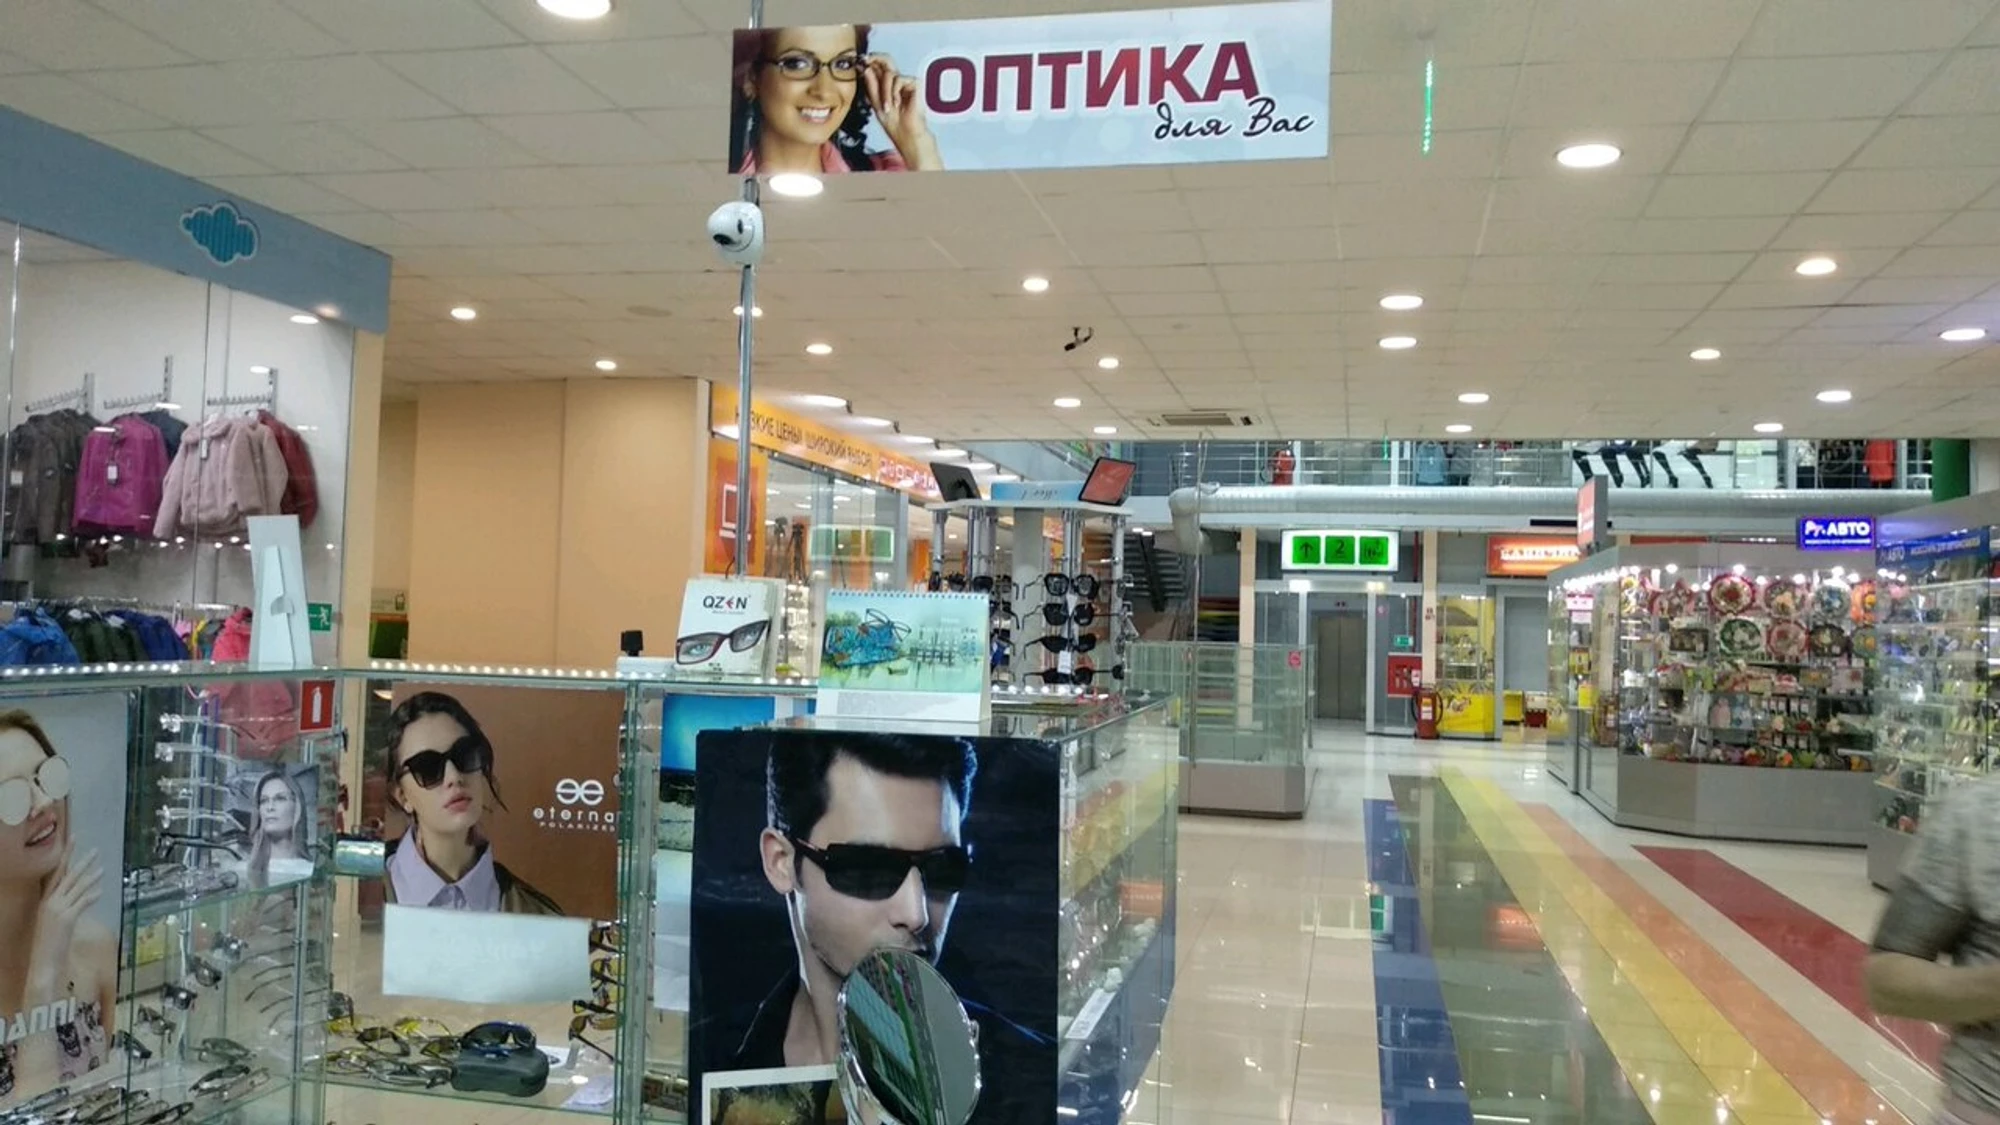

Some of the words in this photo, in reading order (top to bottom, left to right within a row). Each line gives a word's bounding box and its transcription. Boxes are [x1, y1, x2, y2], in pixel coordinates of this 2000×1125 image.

[925, 40, 1260, 114] ОПТИКА
[1154, 102, 1233, 140] для
[1243, 96, 1314, 138] Вас
[776, 420, 803, 444] ЦЕНЫ
[1334, 539, 1345, 554] 2
